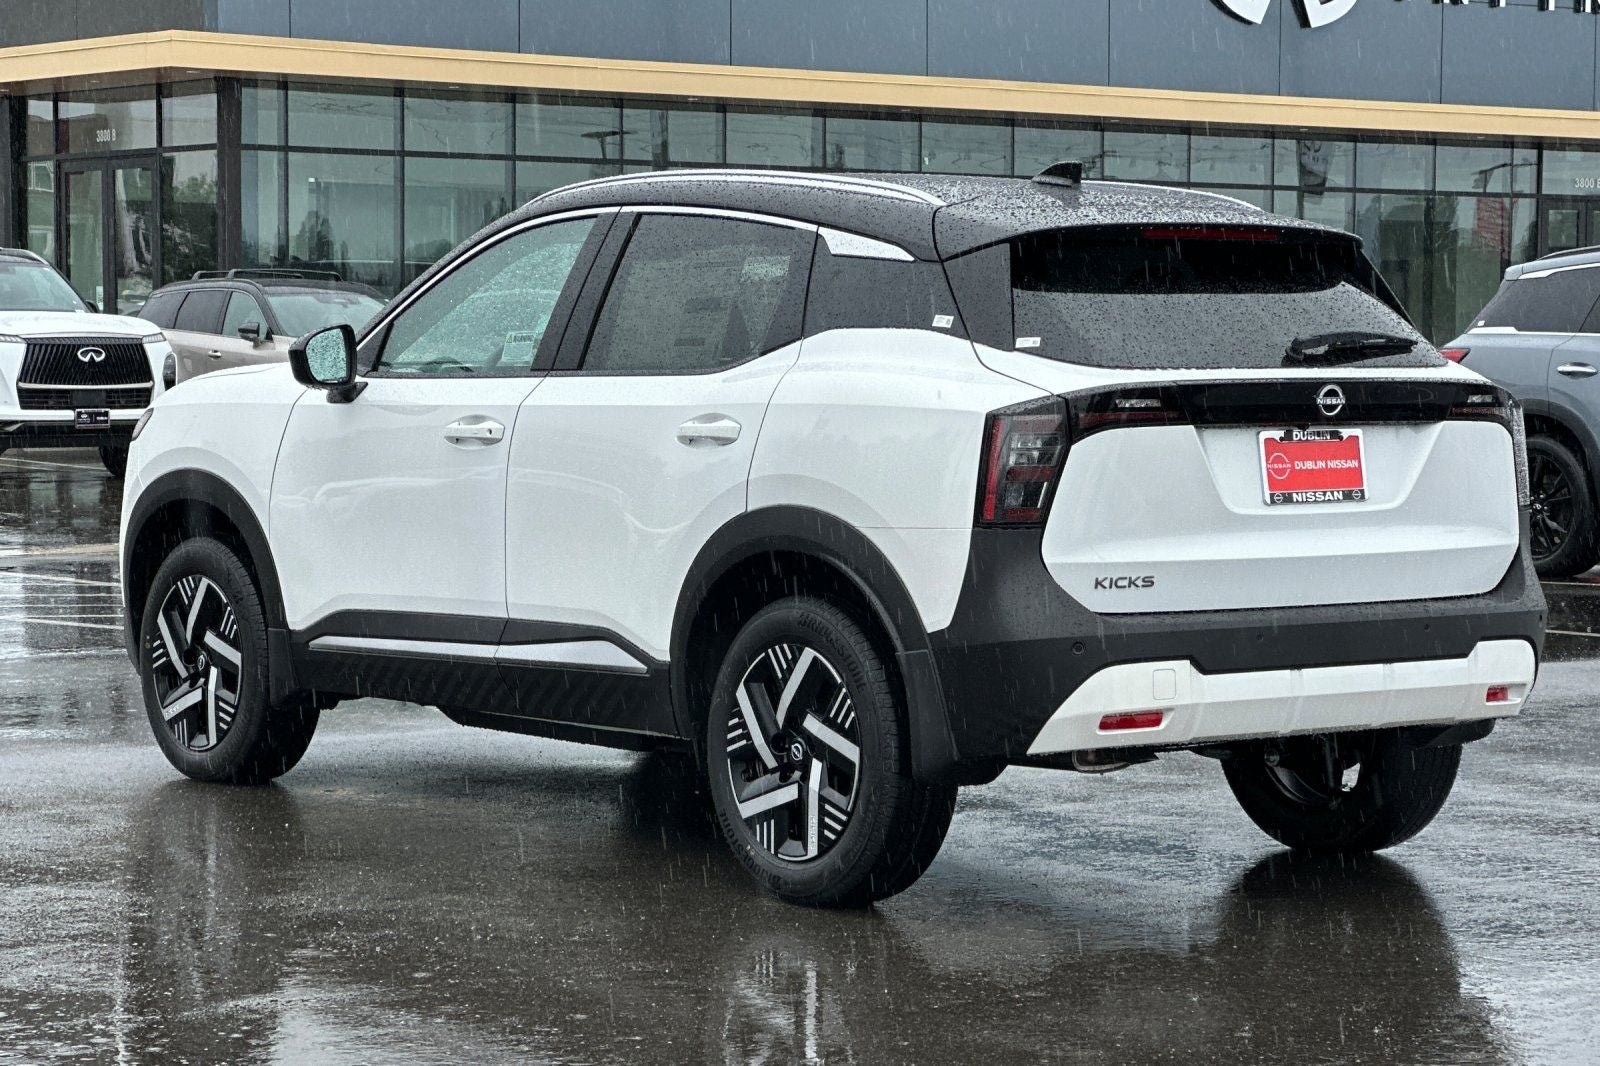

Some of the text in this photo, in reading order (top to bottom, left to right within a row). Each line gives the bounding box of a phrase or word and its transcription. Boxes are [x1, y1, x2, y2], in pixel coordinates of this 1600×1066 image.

[1575, 177, 1594, 188] 3800
[1292, 433, 1331, 441] DUBLIN
[1294, 459, 1359, 470] DUBLIN NISSAN
[1293, 491, 1344, 502] NISSAN
[1094, 575, 1155, 590] KICKS
